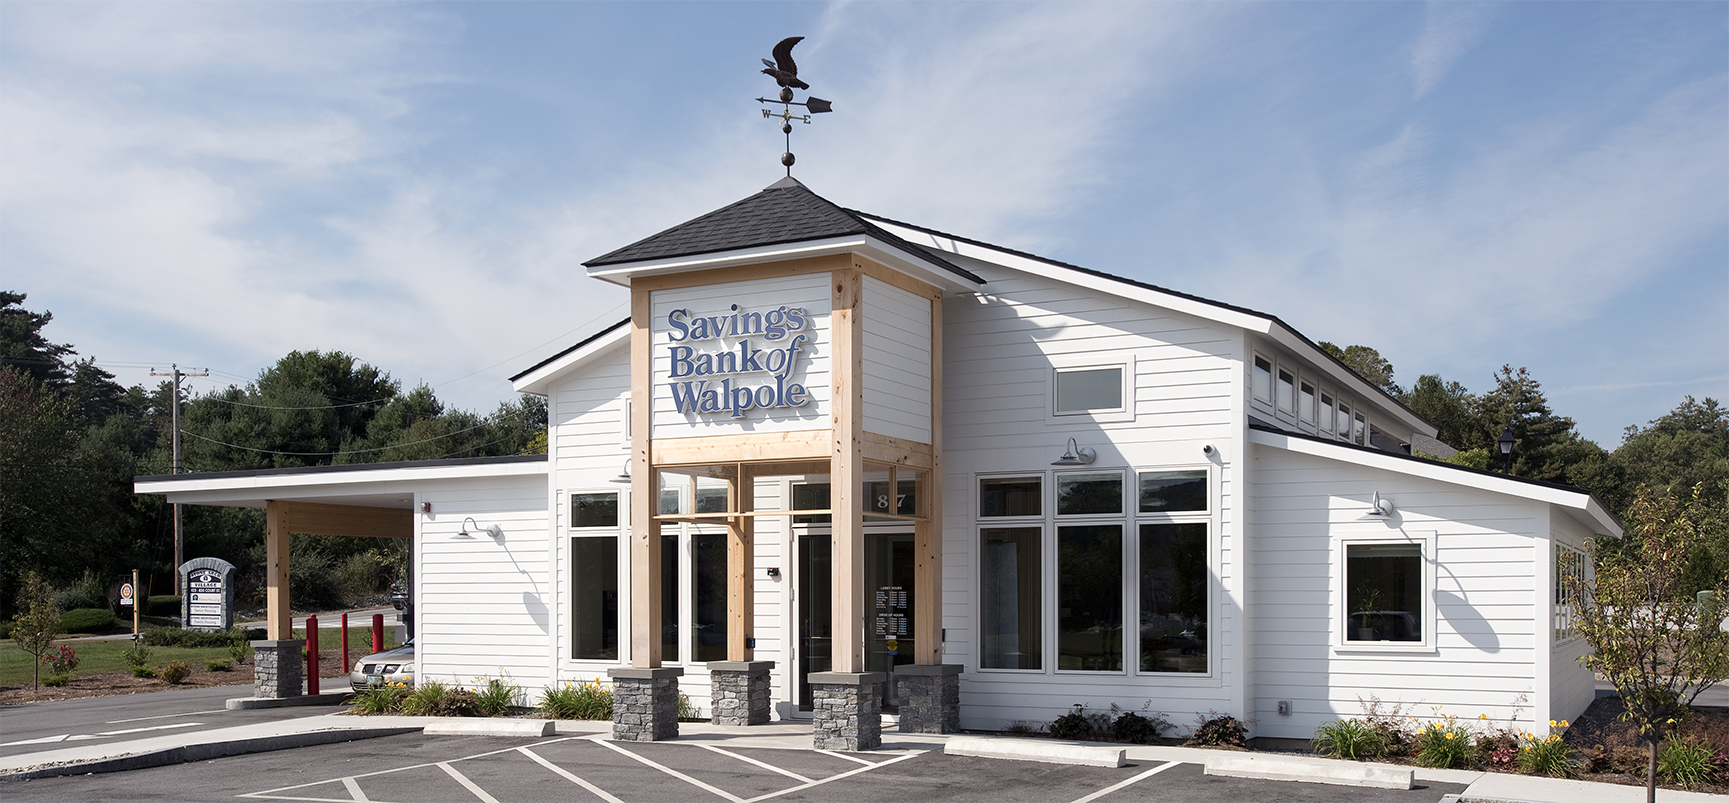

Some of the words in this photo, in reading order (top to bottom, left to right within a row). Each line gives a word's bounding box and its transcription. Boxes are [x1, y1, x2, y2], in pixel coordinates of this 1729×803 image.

[667, 303, 806, 343] Savings
[667, 339, 764, 379] Bank
[765, 334, 807, 380] of
[667, 373, 807, 418] Walpole
[877, 494, 907, 508] 87
